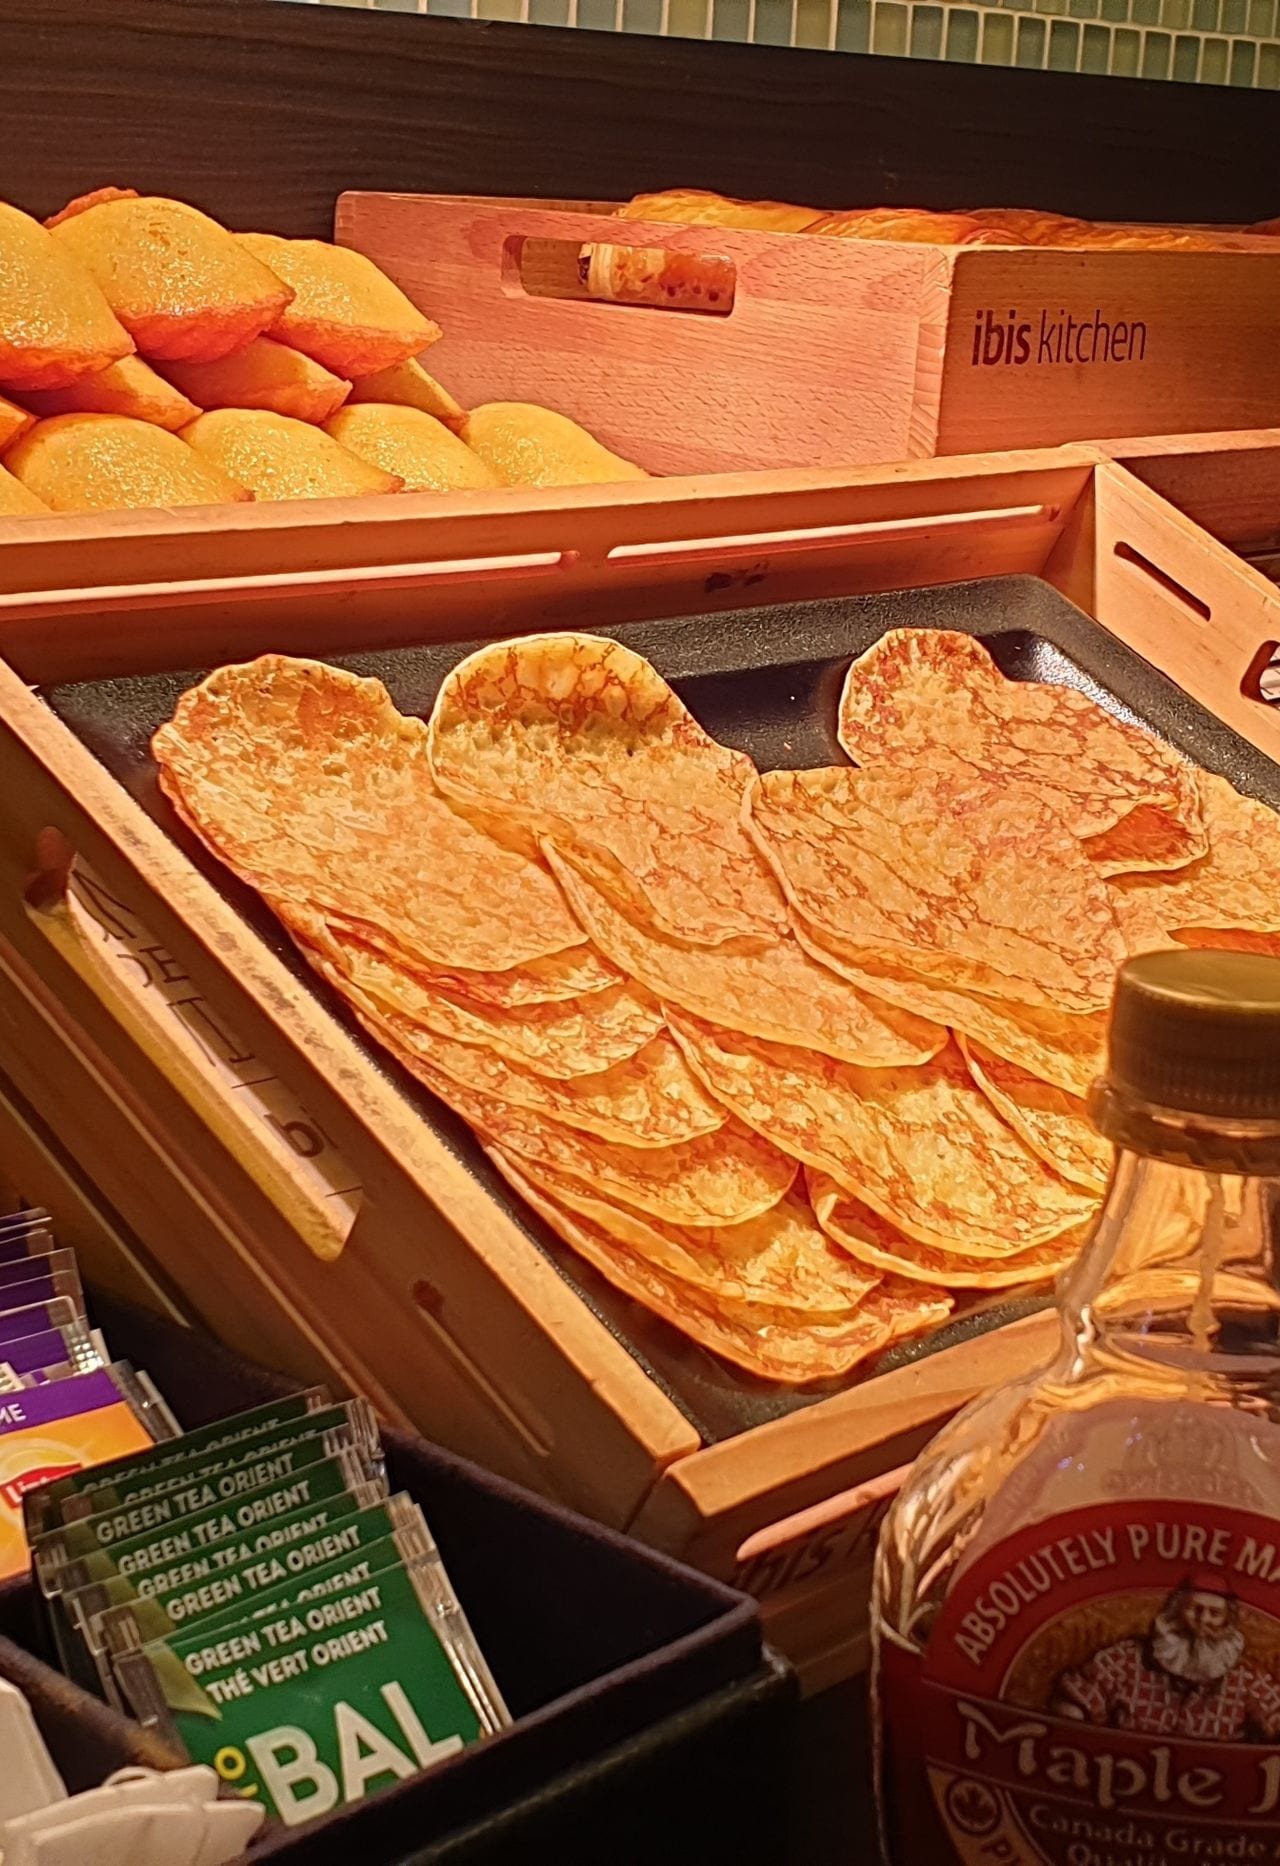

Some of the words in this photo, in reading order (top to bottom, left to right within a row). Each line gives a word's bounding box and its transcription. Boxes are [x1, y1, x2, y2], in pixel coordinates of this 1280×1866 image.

[972, 309, 1031, 366] ibis
[1037, 309, 1147, 364] kitchen
[96, 1500, 171, 1545] GREEN
[171, 1483, 218, 1515] TEA
[217, 1452, 295, 1499] ORIENT
[118, 1532, 192, 1576] GREEN
[190, 1513, 237, 1546] TEA
[236, 1481, 311, 1529] ORIENT
[166, 1574, 243, 1622] GREEN
[241, 1557, 288, 1590] TEA
[286, 1524, 362, 1573] ORIENT
[953, 1523, 1117, 1667] ABSOLUTELY
[1128, 1522, 1233, 1567] PURE
[184, 1630, 262, 1677] GREEN
[260, 1615, 308, 1648] TEA
[305, 1585, 383, 1632] ORIENT
[205, 1666, 254, 1704] THÉ
[249, 1649, 310, 1688] VERT
[310, 1619, 389, 1667] ORIENT
[244, 1680, 466, 1828] BAL
[956, 1699, 1224, 1810] Maple
[1029, 1804, 1156, 1850] Canada
[1164, 1827, 1267, 1859] Grade
